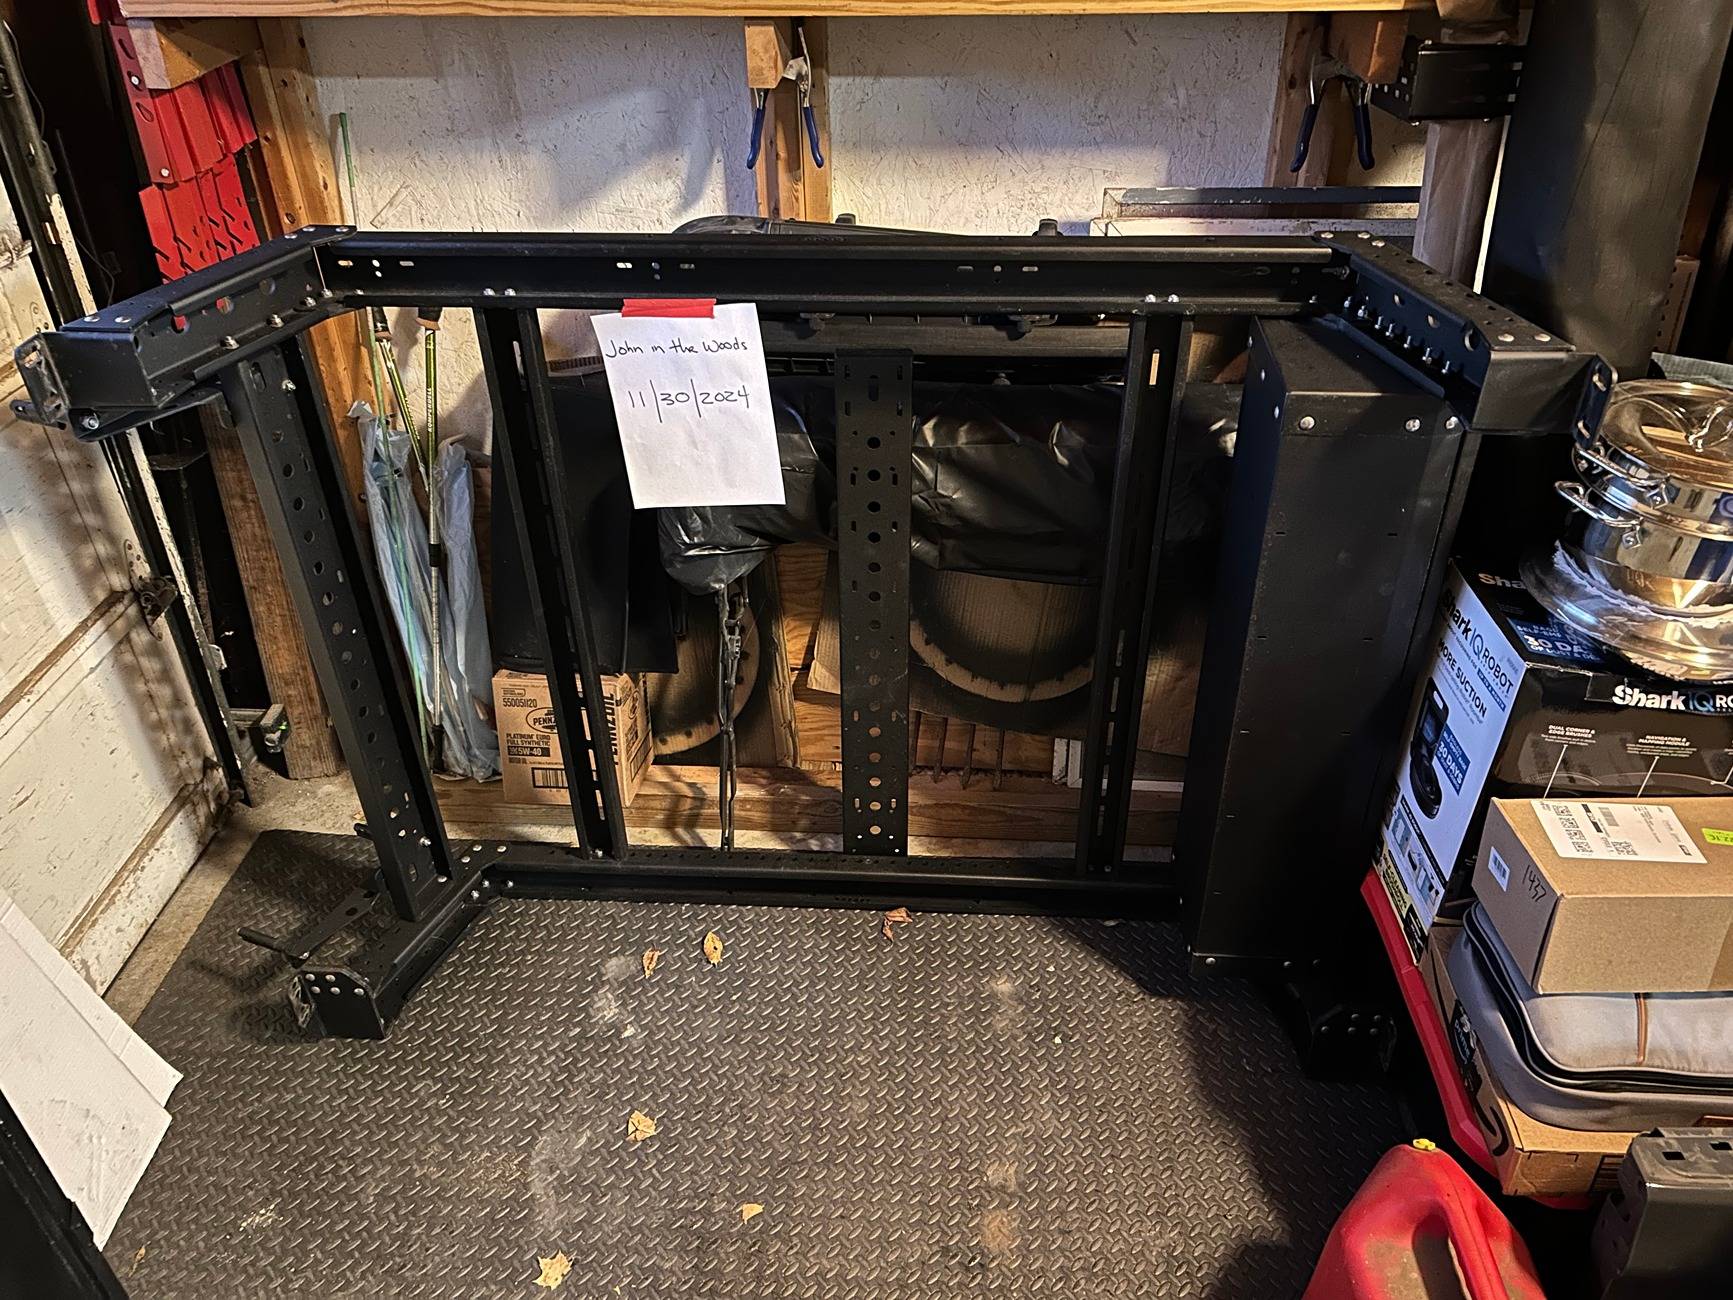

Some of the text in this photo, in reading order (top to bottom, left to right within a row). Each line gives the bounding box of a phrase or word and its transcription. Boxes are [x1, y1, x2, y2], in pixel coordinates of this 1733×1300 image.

[606, 337, 748, 358] John in the Woods
[628, 378, 750, 423] 11/30/2024
[1524, 635, 1552, 648] 30
[1469, 628, 1484, 660] IQ
[1483, 648, 1514, 694] ROBOT
[1439, 638, 1459, 673] MORE
[1456, 667, 1487, 718] SUCTION
[1612, 685, 1686, 710] Shark
[1687, 689, 1715, 712] IQ
[518, 747, 542, 755] 5W-40
[1446, 754, 1463, 784] DAYS
